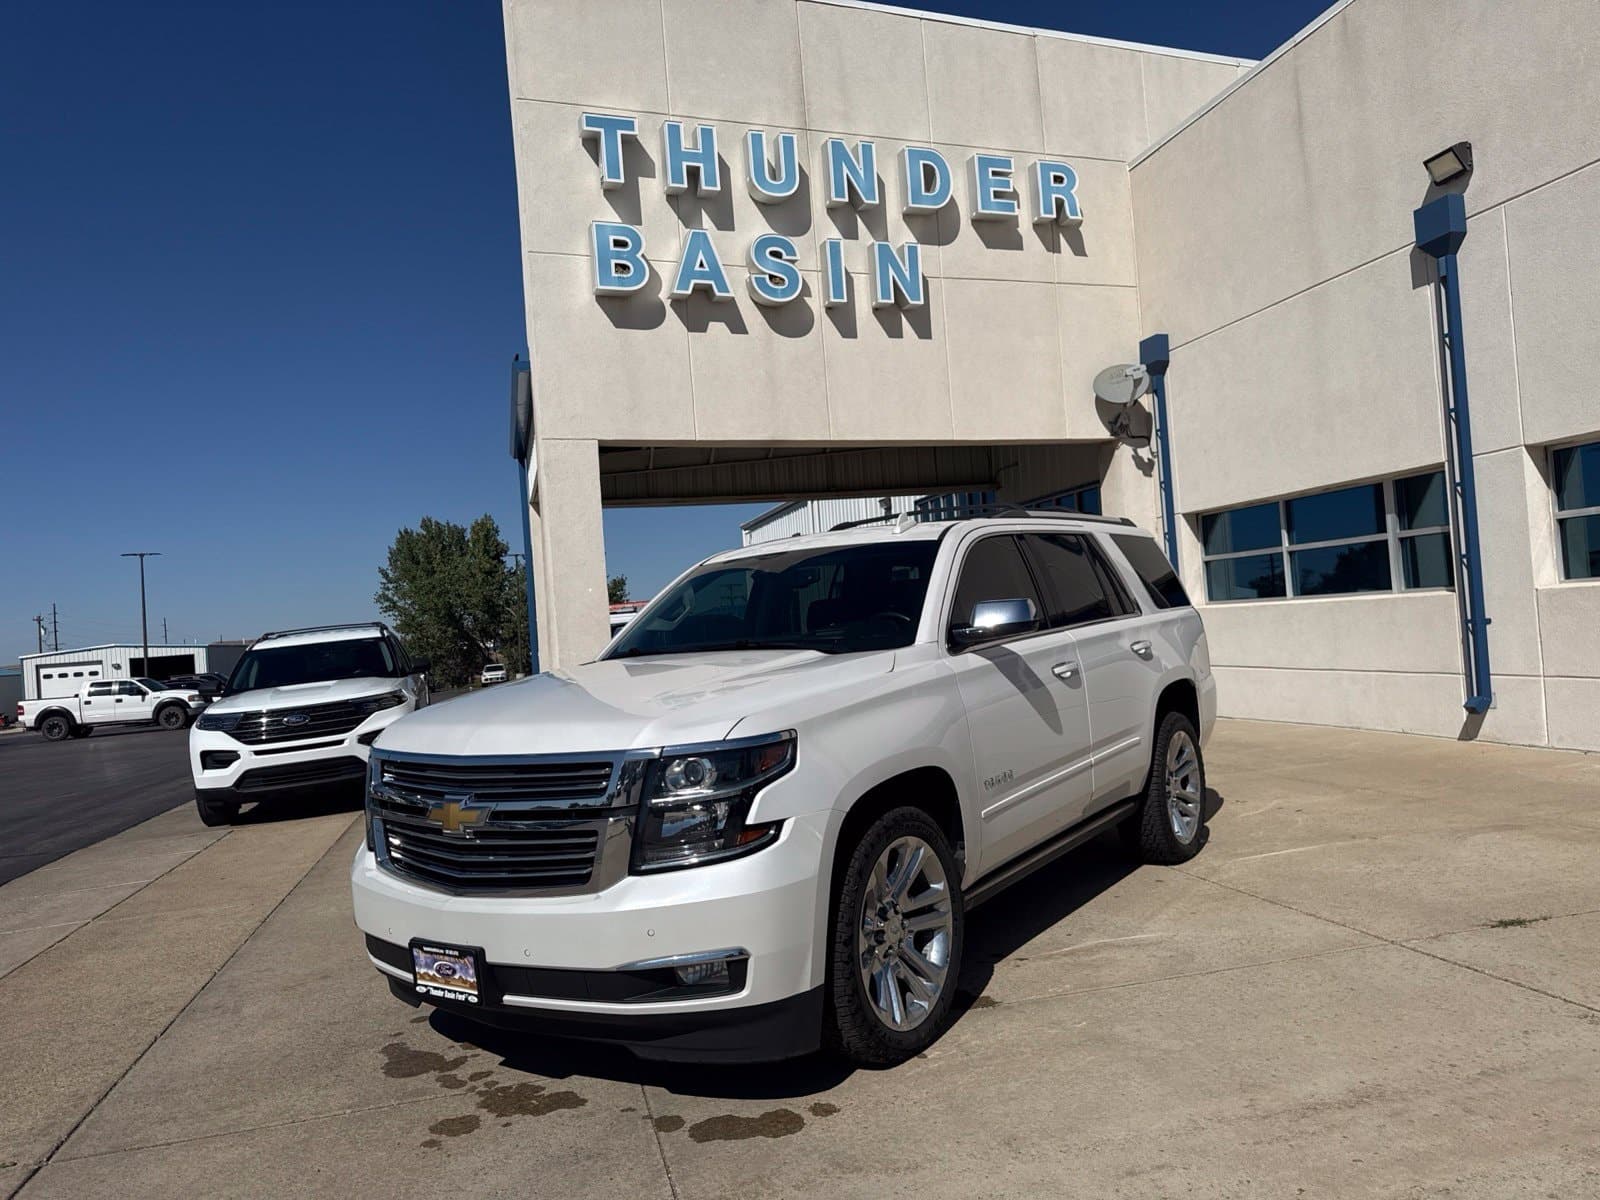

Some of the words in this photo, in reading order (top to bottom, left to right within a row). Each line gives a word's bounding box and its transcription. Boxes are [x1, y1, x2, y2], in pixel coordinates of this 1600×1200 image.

[580, 112, 1083, 226] THUNDER
[590, 220, 925, 309] BASIN
[436, 963, 455, 976] Ford
